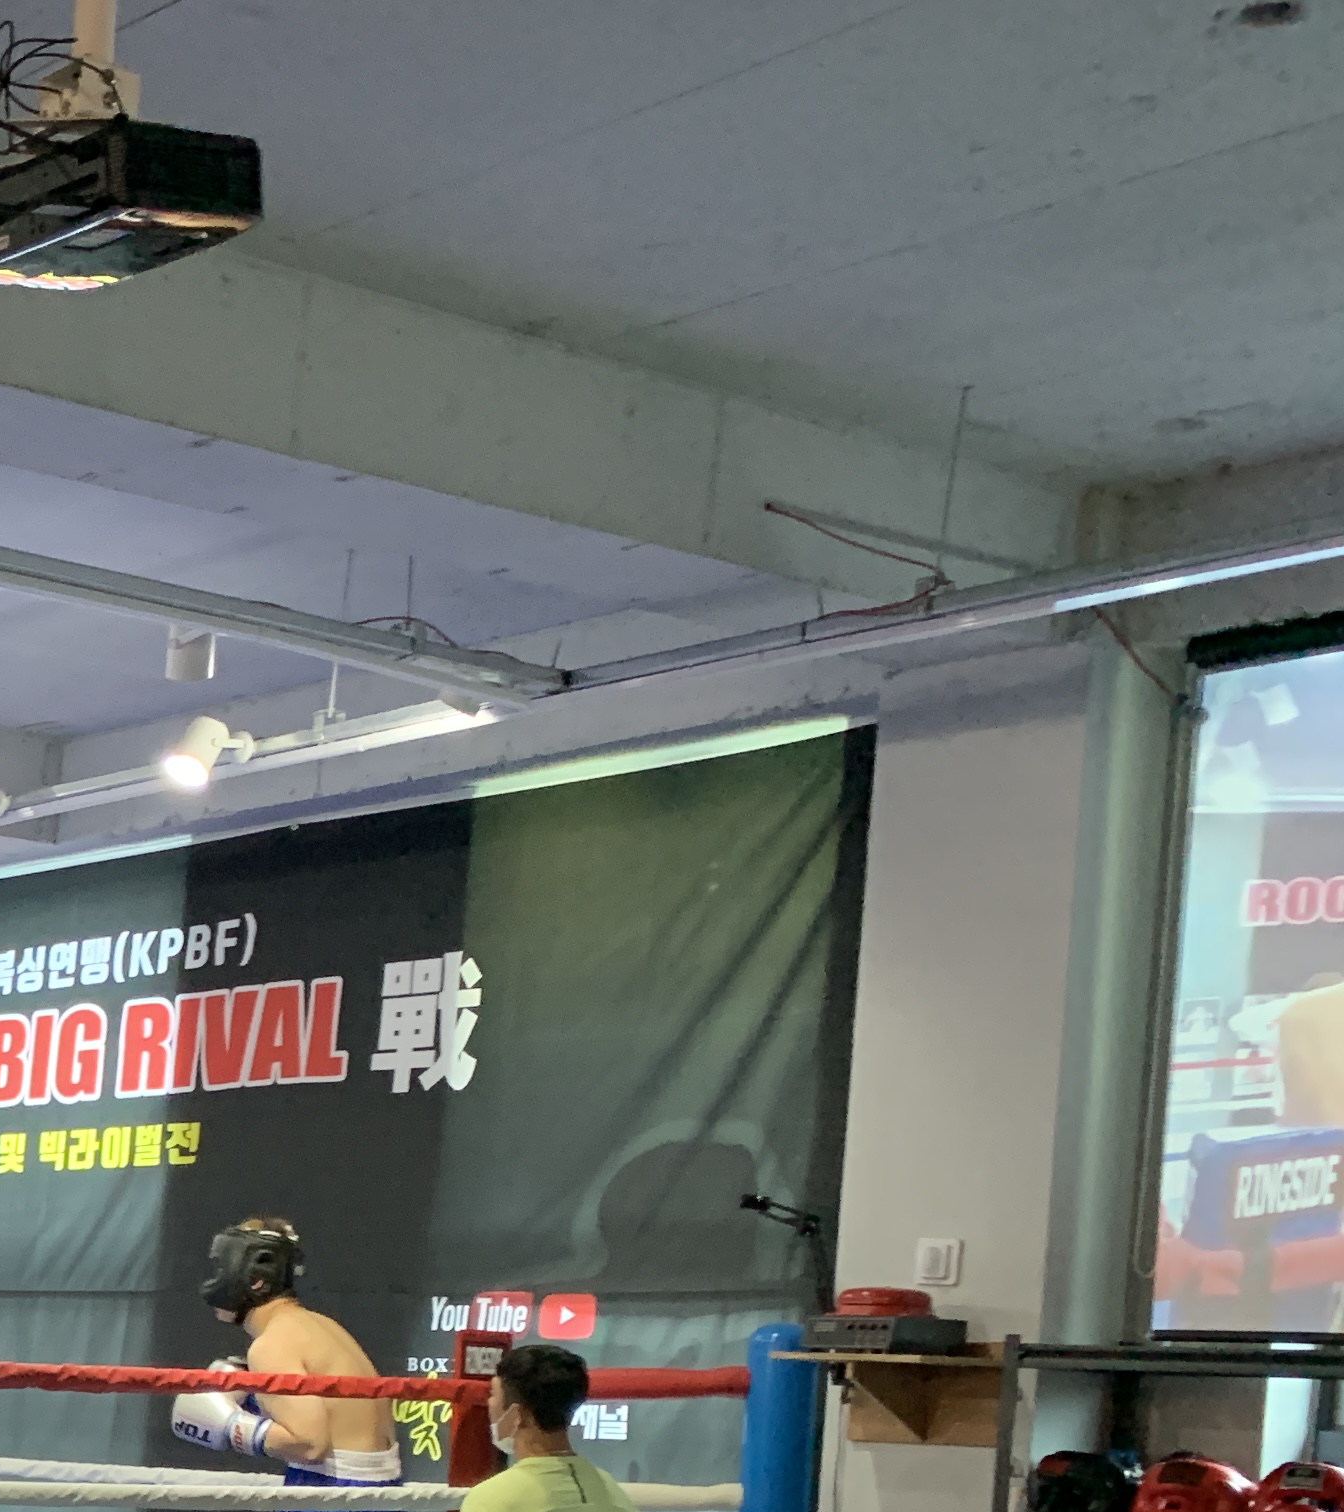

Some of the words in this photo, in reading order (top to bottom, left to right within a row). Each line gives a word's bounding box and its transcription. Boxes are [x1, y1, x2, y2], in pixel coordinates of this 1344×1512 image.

[115, 976, 349, 1099] RIVAL
[371, 951, 482, 1094] 戰
[39, 1122, 201, 1172] 빅라이벌전
[1234, 1154, 1340, 1219] RINGSIDE
[407, 1356, 456, 1374] BOX
